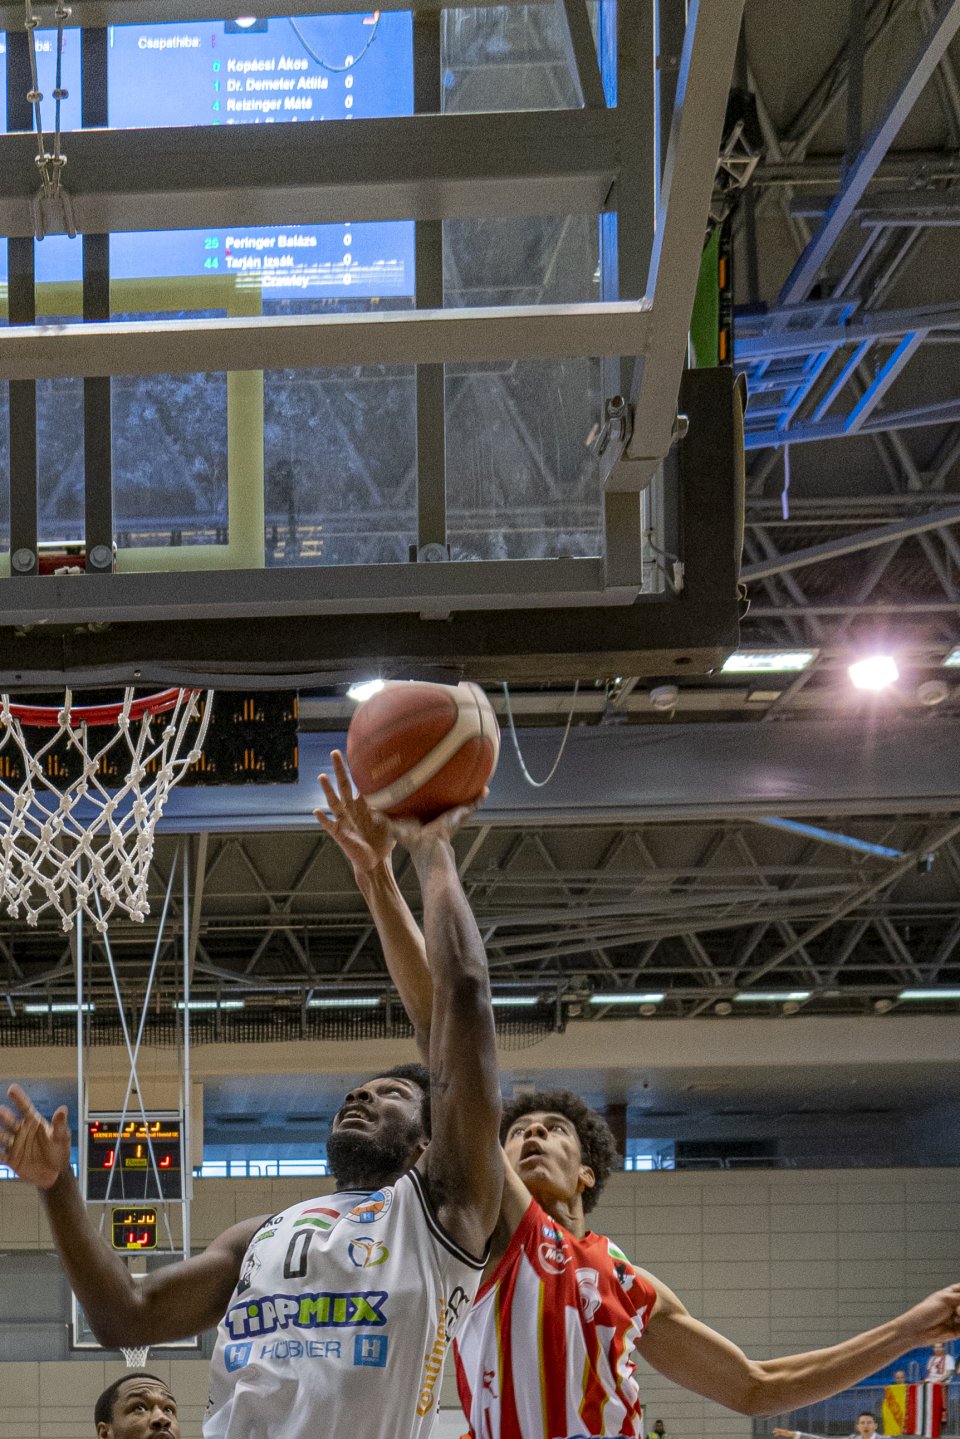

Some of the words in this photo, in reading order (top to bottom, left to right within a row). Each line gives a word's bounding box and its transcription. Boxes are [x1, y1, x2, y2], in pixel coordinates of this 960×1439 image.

[227, 79, 242, 92] Dr.
[246, 78, 295, 91] Demeter
[297, 76, 328, 90] Attila
[345, 74, 353, 88] 0
[345, 95, 353, 108] 0
[278, 234, 317, 248] Balázs
[343, 233, 352, 246] 0
[204, 256, 219, 269] 44
[260, 1340, 342, 1359] HÜBNER
